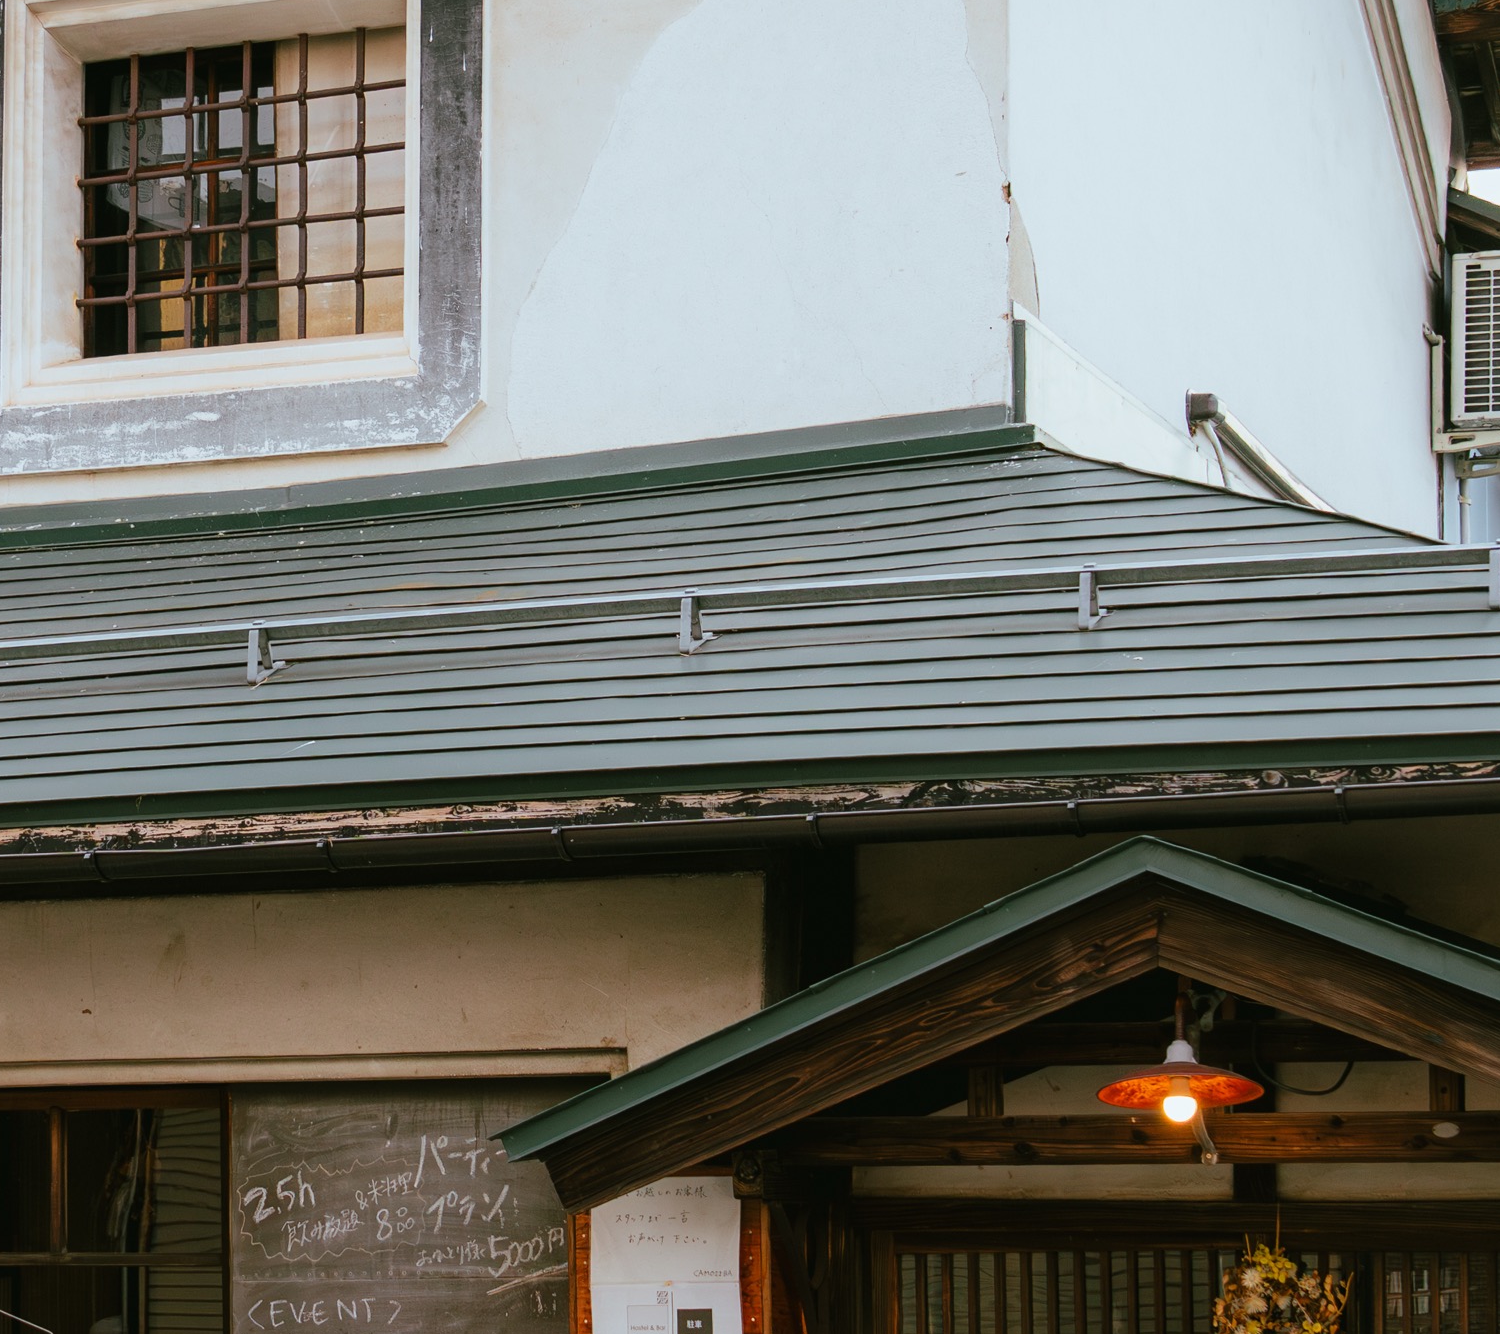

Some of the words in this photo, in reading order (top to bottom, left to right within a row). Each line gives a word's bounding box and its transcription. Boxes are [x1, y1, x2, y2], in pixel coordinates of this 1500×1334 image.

[243, 1168, 316, 1223] 2.5h
[426, 1184, 510, 1234] プラン
[281, 1209, 365, 1252] 飲み放題
